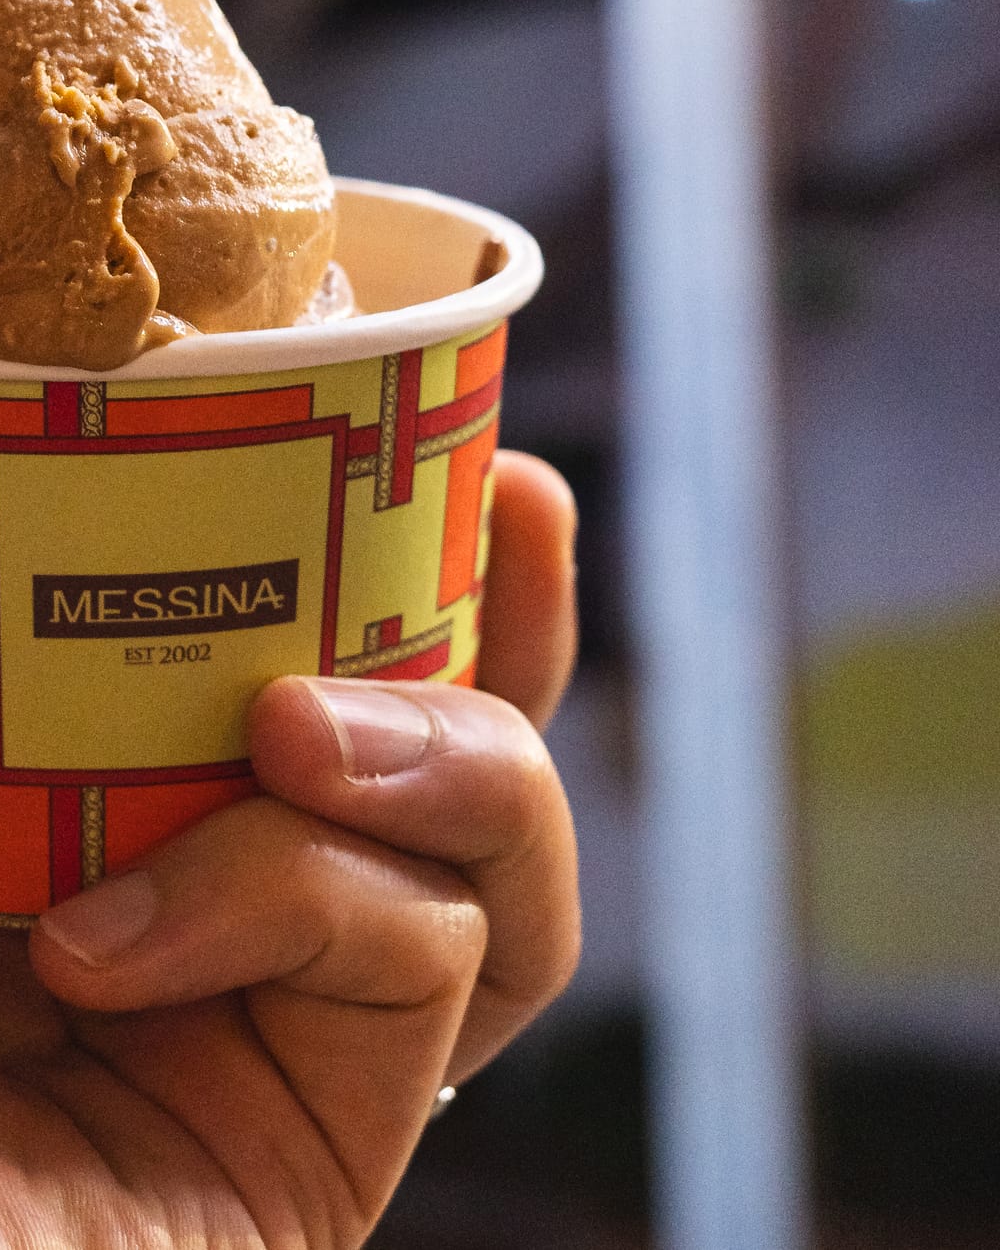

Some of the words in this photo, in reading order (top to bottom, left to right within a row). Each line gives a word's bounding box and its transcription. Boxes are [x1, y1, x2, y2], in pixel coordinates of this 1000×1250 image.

[50, 577, 285, 623] MESSINA
[124, 647, 156, 665] EST
[159, 643, 212, 664] 2002
